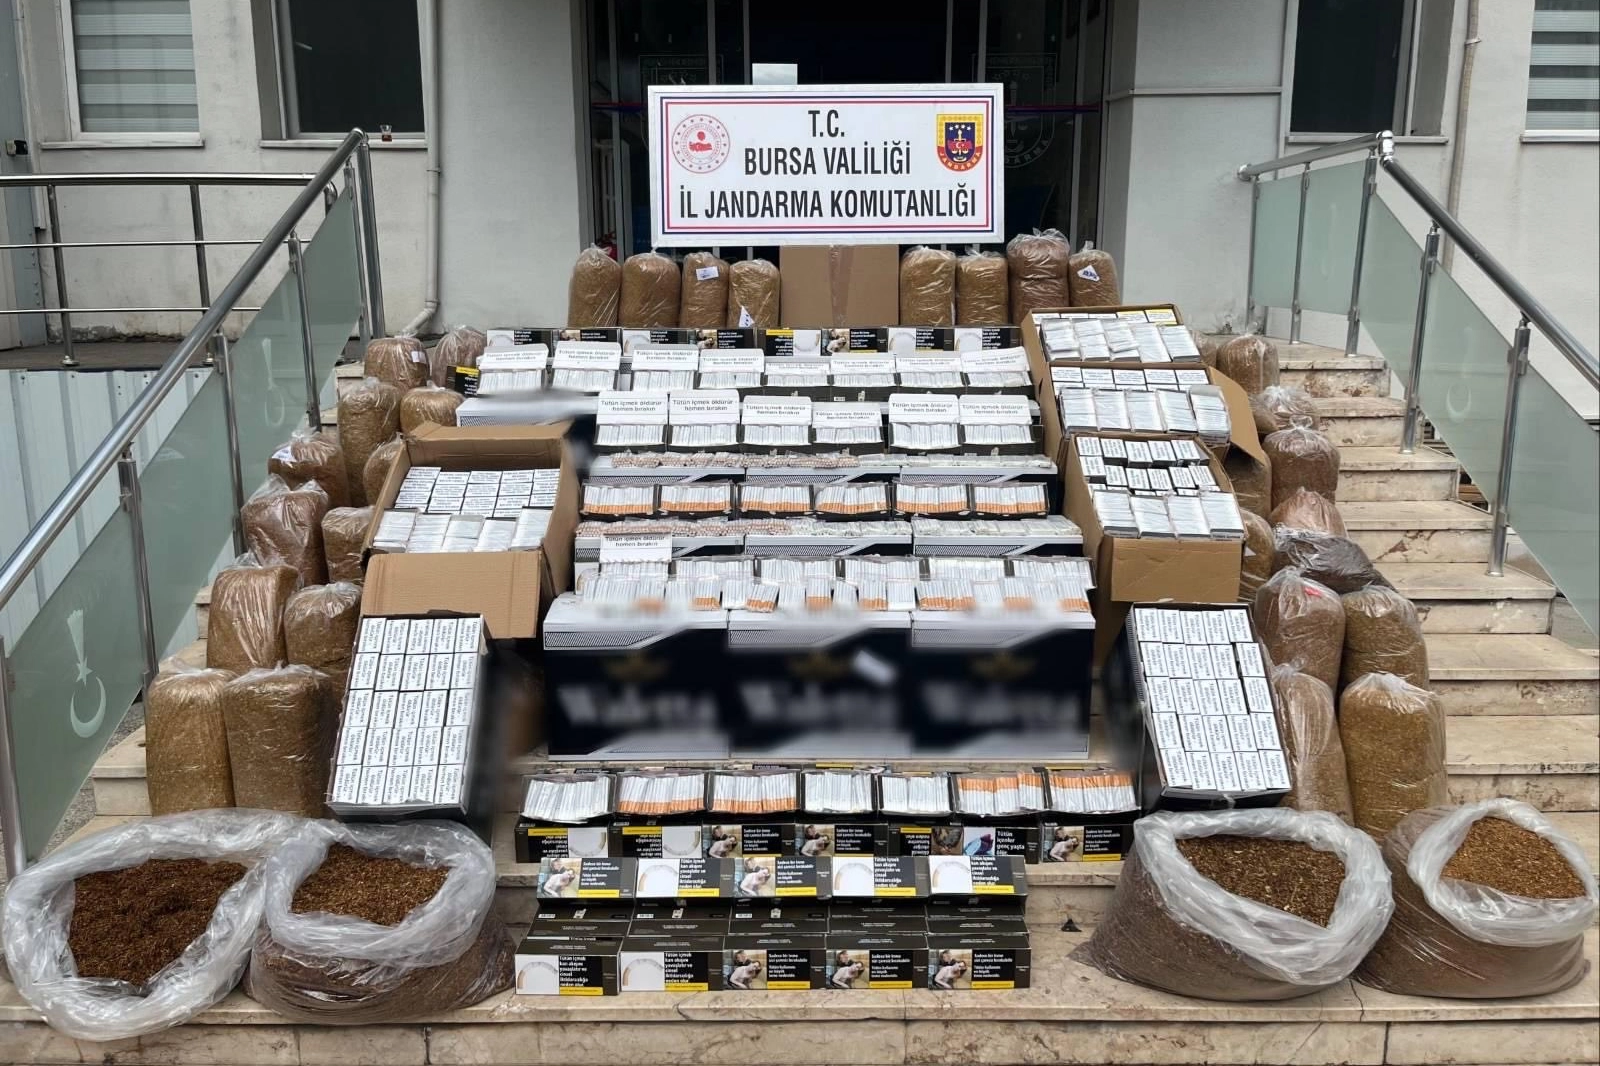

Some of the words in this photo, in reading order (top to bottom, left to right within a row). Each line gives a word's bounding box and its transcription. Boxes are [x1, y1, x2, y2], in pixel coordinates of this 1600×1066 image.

[808, 110, 845, 137] T.C.
[745, 147, 816, 175] BURSA
[824, 141, 910, 174] VALİLİĞİ
[940, 152, 981, 170] JANDARMA
[680, 185, 697, 218] İL
[705, 191, 822, 218] JANDARMA
[831, 183, 975, 217] KOMUTANLIĞI
